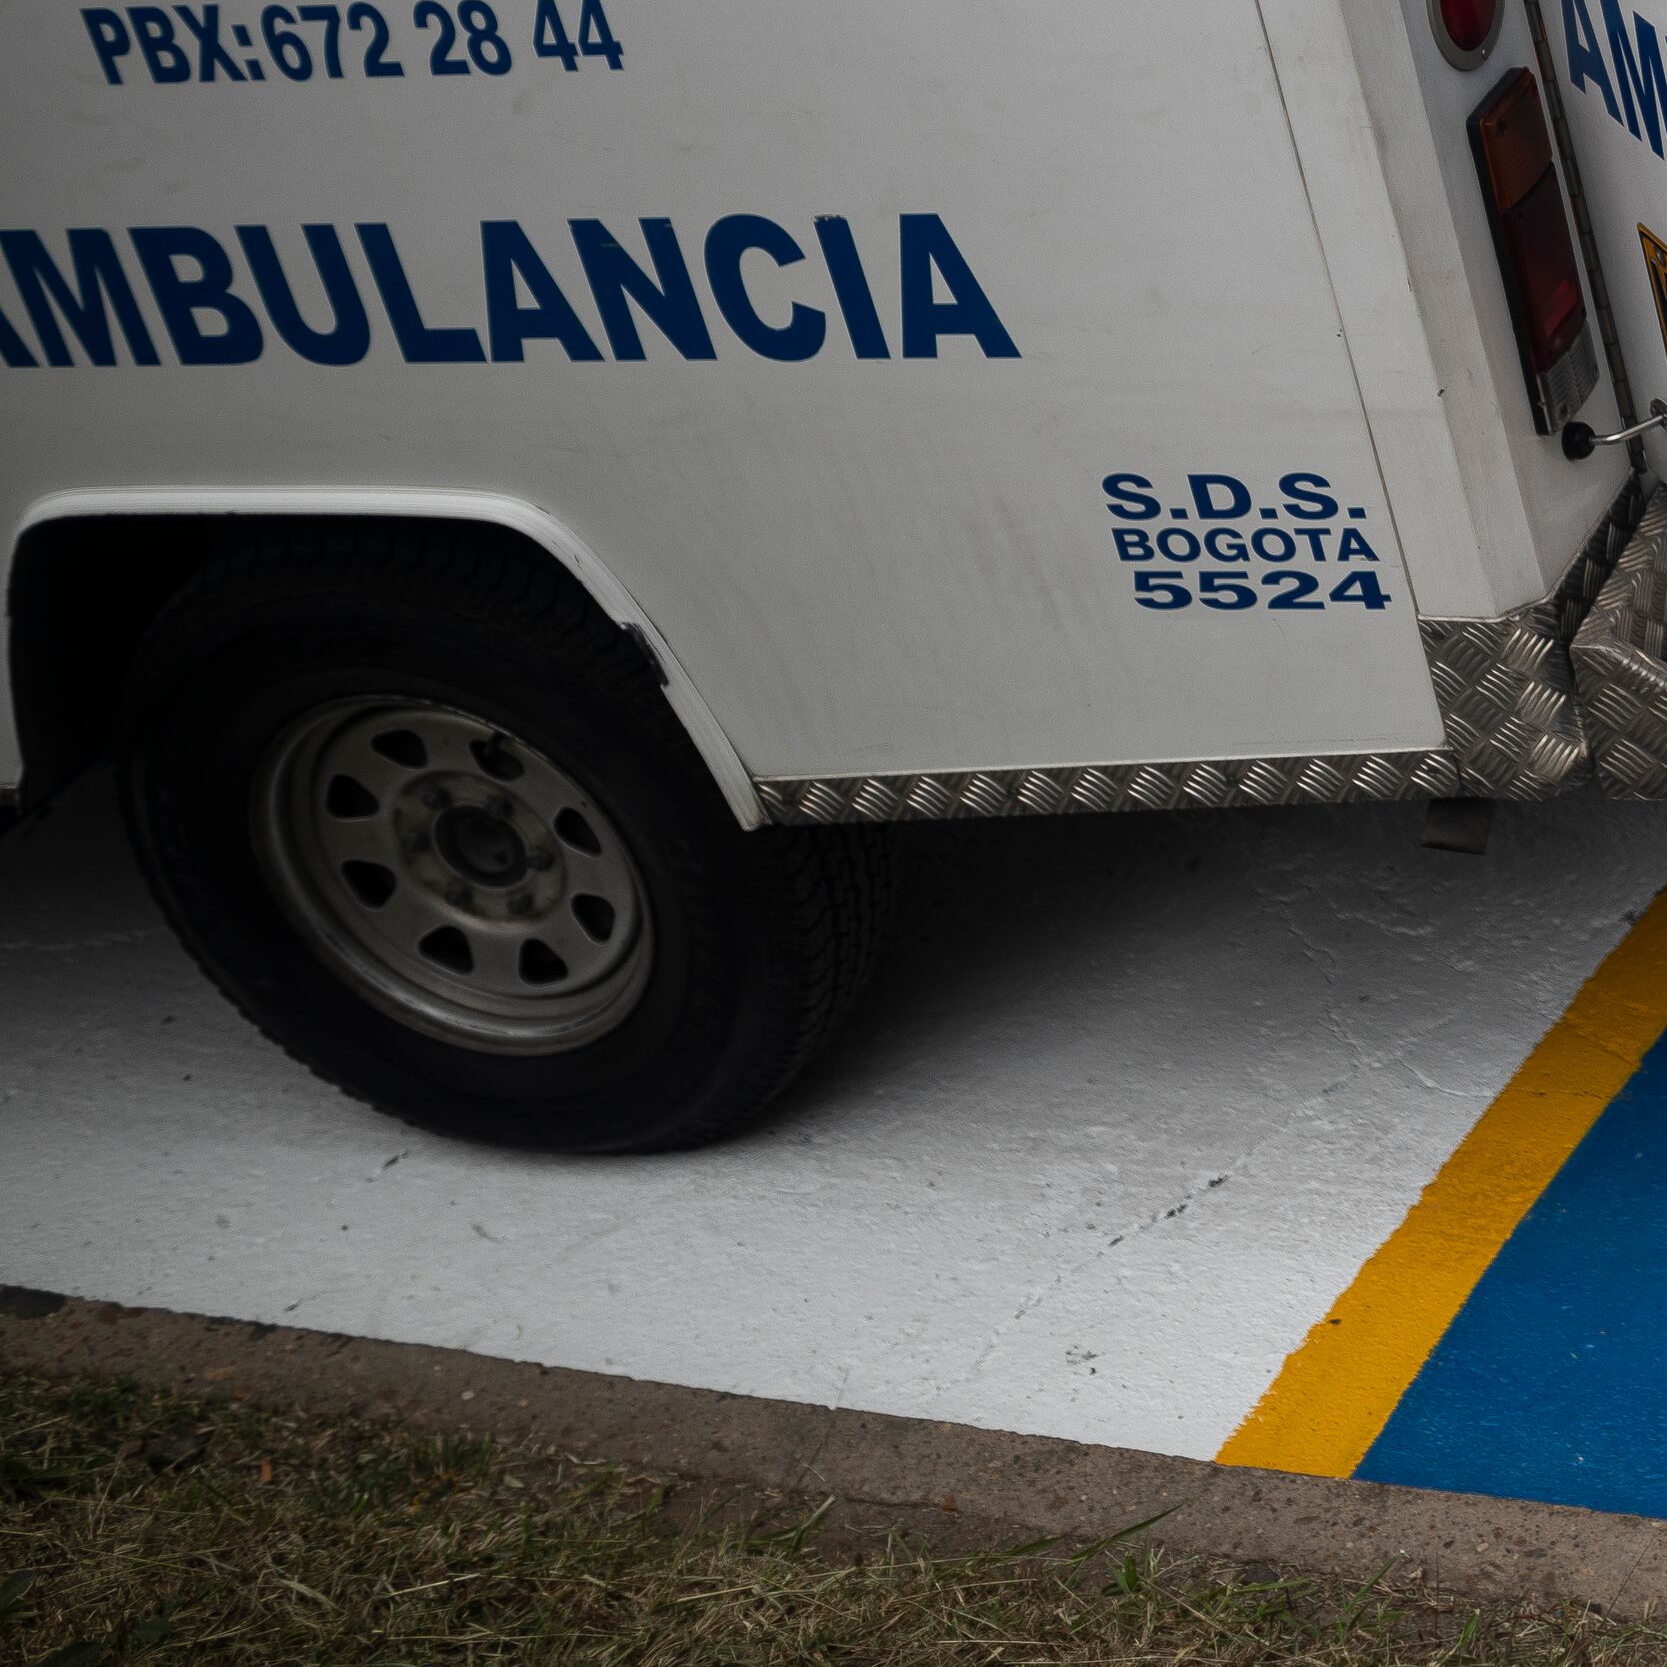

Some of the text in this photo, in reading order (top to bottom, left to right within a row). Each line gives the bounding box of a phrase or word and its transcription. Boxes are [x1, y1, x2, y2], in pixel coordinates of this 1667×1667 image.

[79, 2, 405, 85] PBX:672
[1102, 472, 1367, 521] S.D.S.
[1111, 527, 1381, 563] BOGOTA
[1134, 570, 1392, 610] 5524
